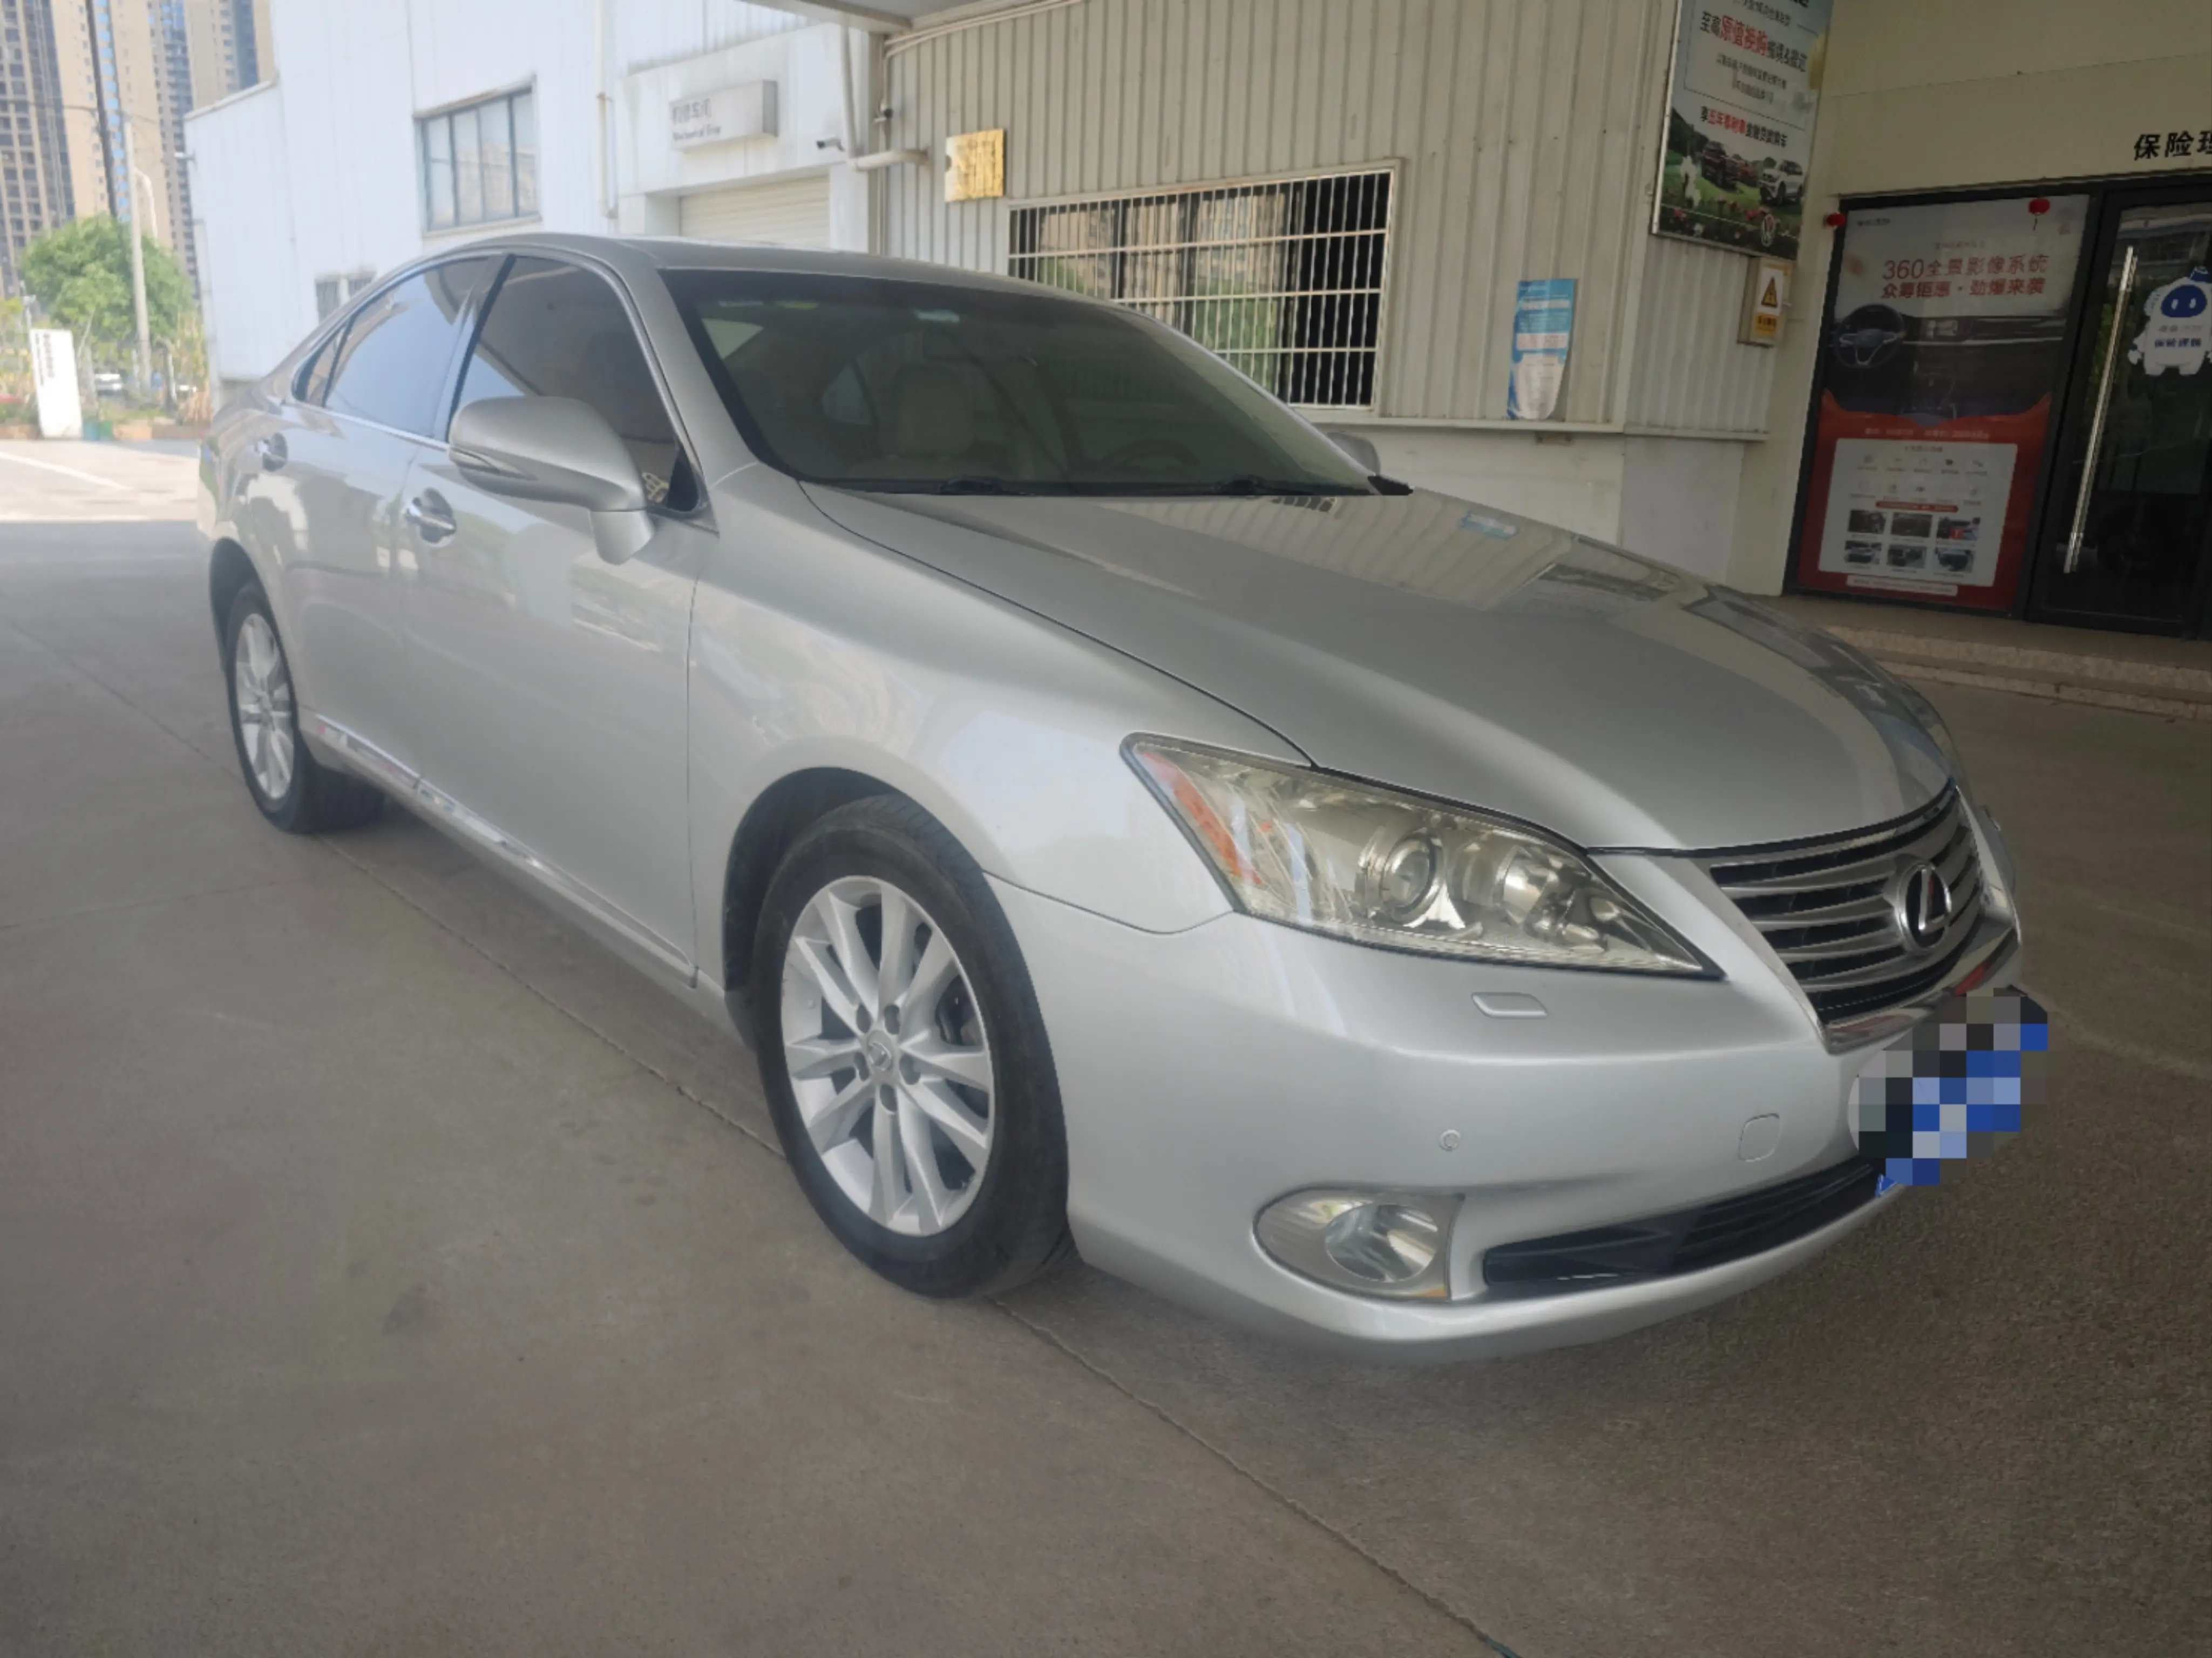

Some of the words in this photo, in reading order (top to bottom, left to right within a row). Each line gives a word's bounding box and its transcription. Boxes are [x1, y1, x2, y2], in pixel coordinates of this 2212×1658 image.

[1882, 254, 2050, 280] 360全景影像系统
